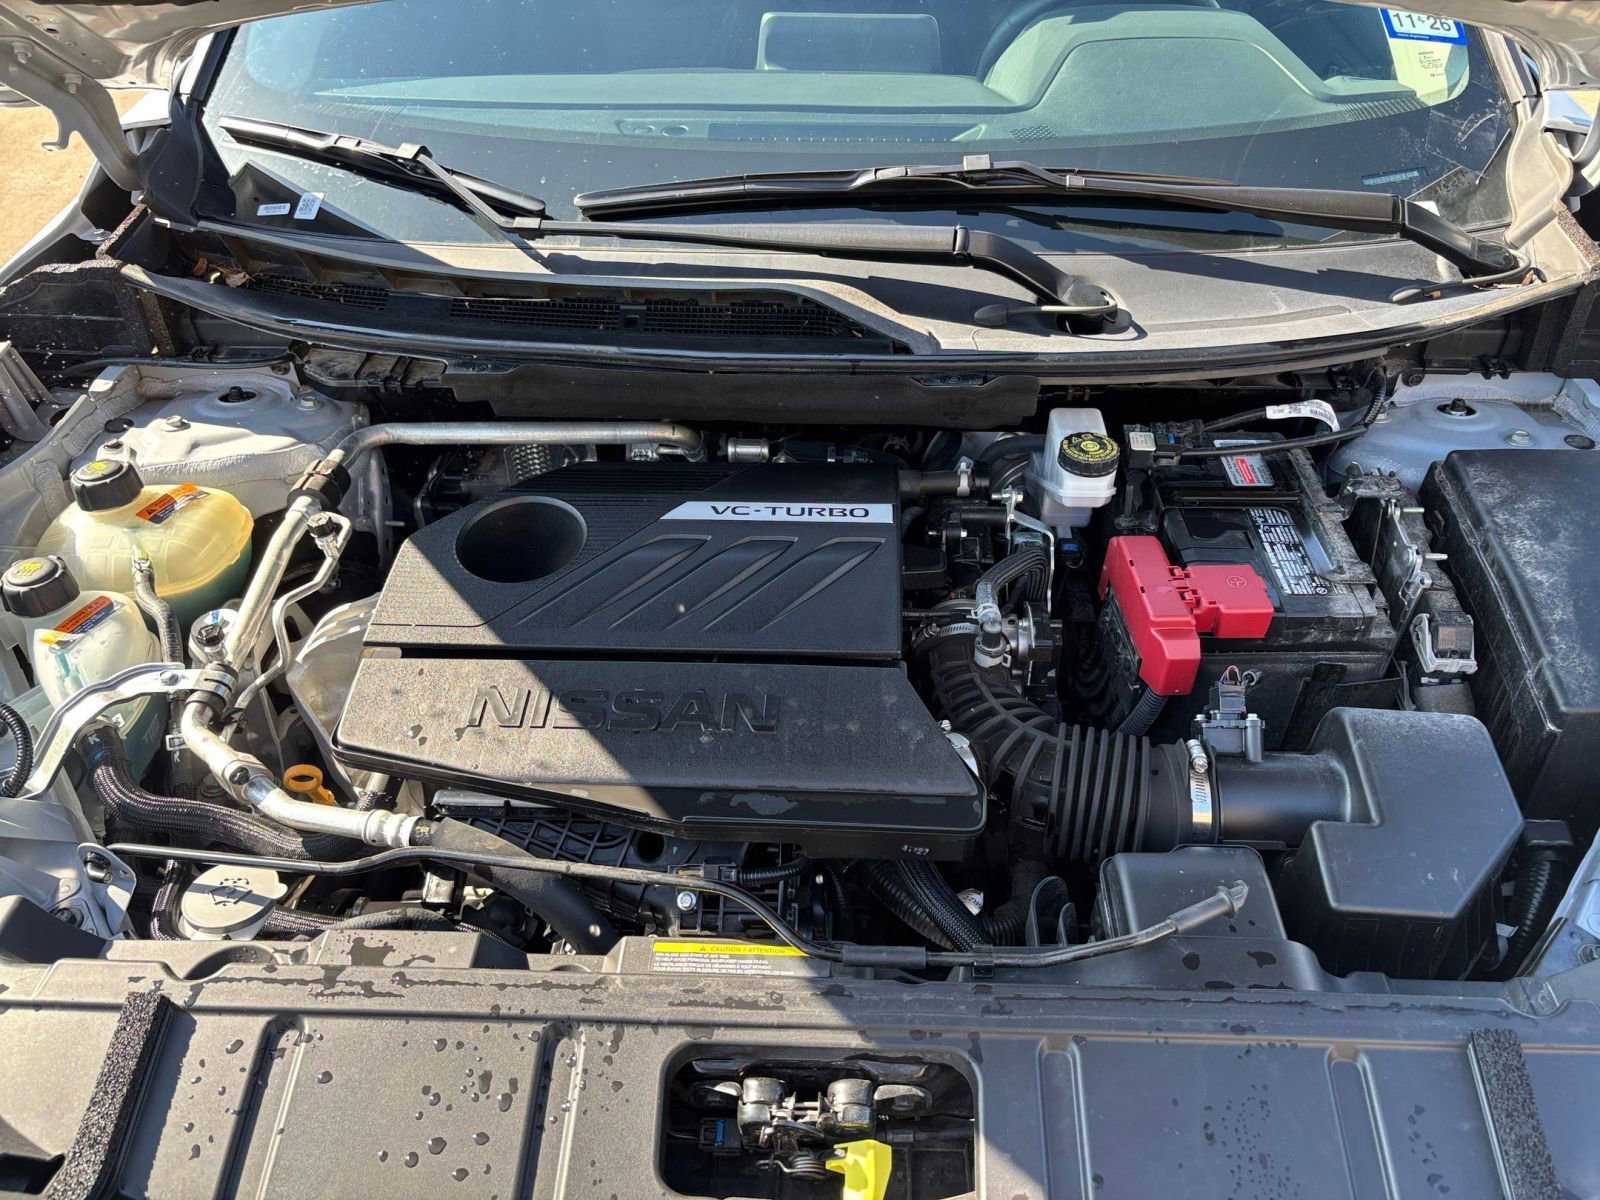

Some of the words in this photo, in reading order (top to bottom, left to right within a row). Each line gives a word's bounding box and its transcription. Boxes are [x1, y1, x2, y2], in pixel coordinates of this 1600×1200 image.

[710, 505, 870, 518] VC-TURBO
[466, 687, 780, 735] NISSAN
[710, 945, 740, 953] CAUTION
[747, 946, 786, 955] ATTENTION
